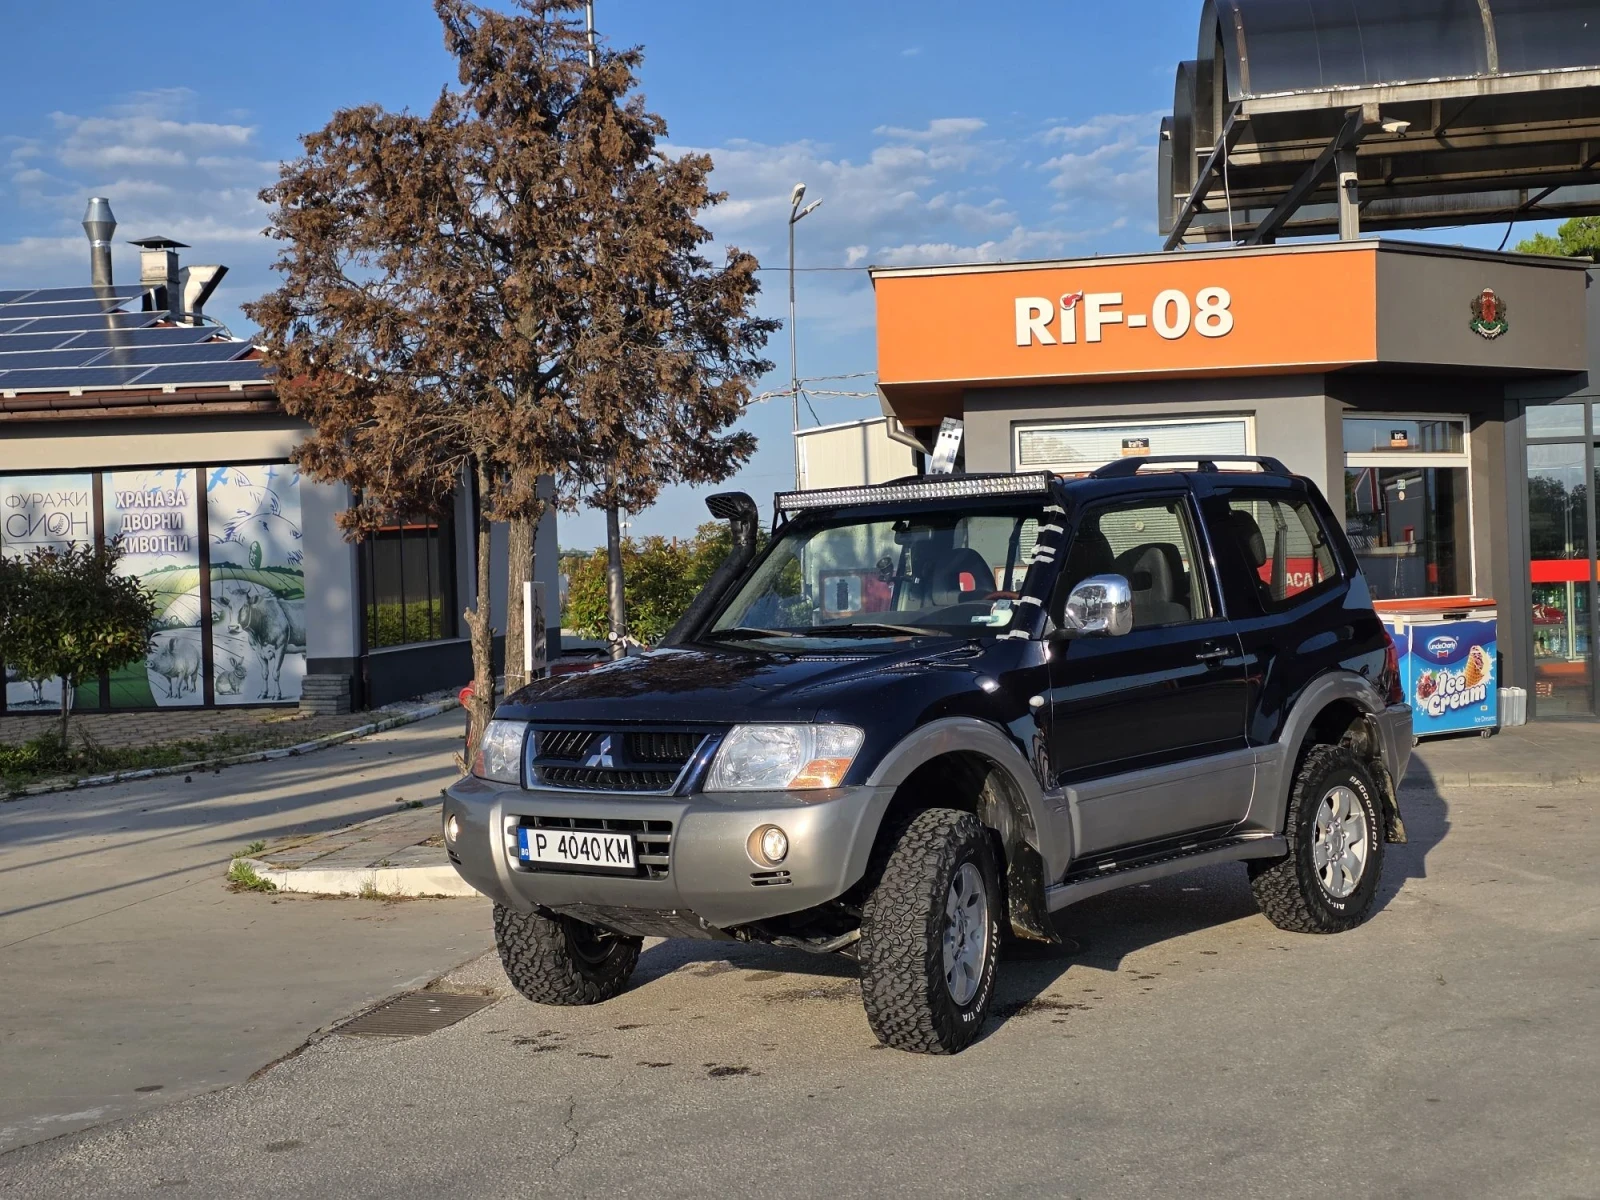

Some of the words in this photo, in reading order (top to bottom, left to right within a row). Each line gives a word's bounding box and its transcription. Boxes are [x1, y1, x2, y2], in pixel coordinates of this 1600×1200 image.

[5, 492, 88, 509] ФУРАЖИ
[115, 490, 165, 508] ХРАНА
[167, 490, 187, 507] ЗА
[6, 511, 89, 537] СИОН
[120, 512, 182, 533] ДВОРНИ
[1438, 672, 1466, 696] Ice
[1427, 684, 1487, 717] Cream
[1349, 775, 1378, 851] BFGoodrich
[535, 833, 547, 858] P
[975, 920, 998, 1013] All-Terrain
